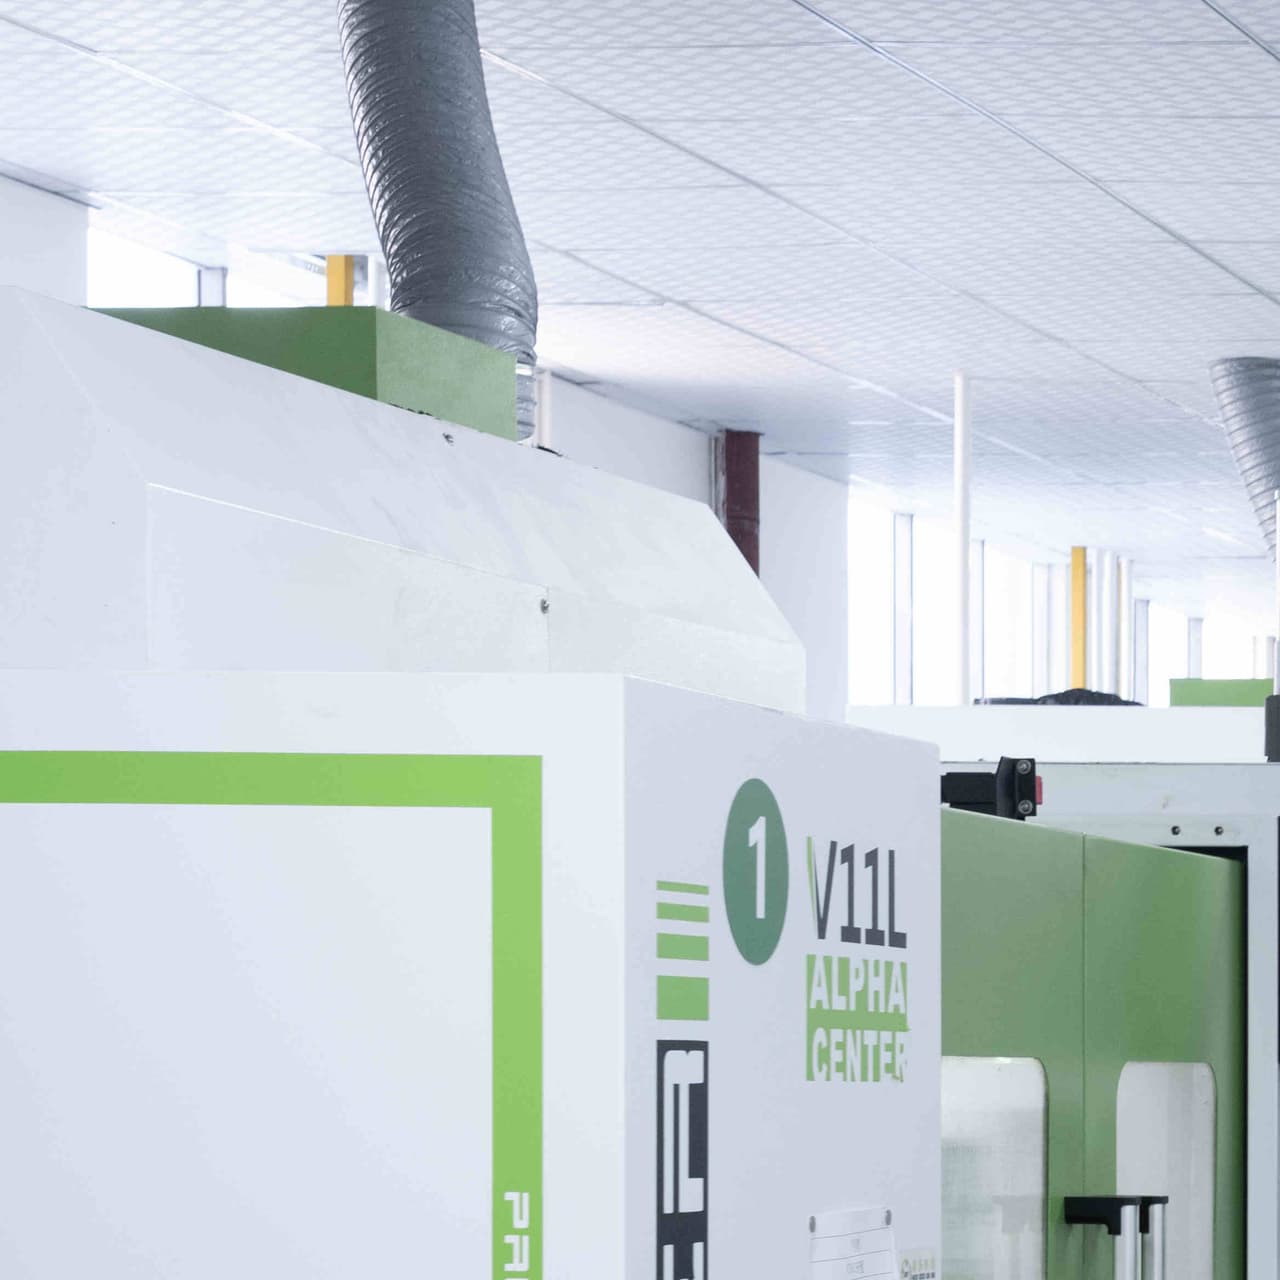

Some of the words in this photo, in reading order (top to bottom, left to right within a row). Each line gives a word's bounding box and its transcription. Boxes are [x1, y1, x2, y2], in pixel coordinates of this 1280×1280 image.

[747, 815, 768, 920] 1
[806, 836, 907, 948] V11L
[809, 954, 908, 1014] ALPHA
[811, 1026, 908, 1083] CENTER
